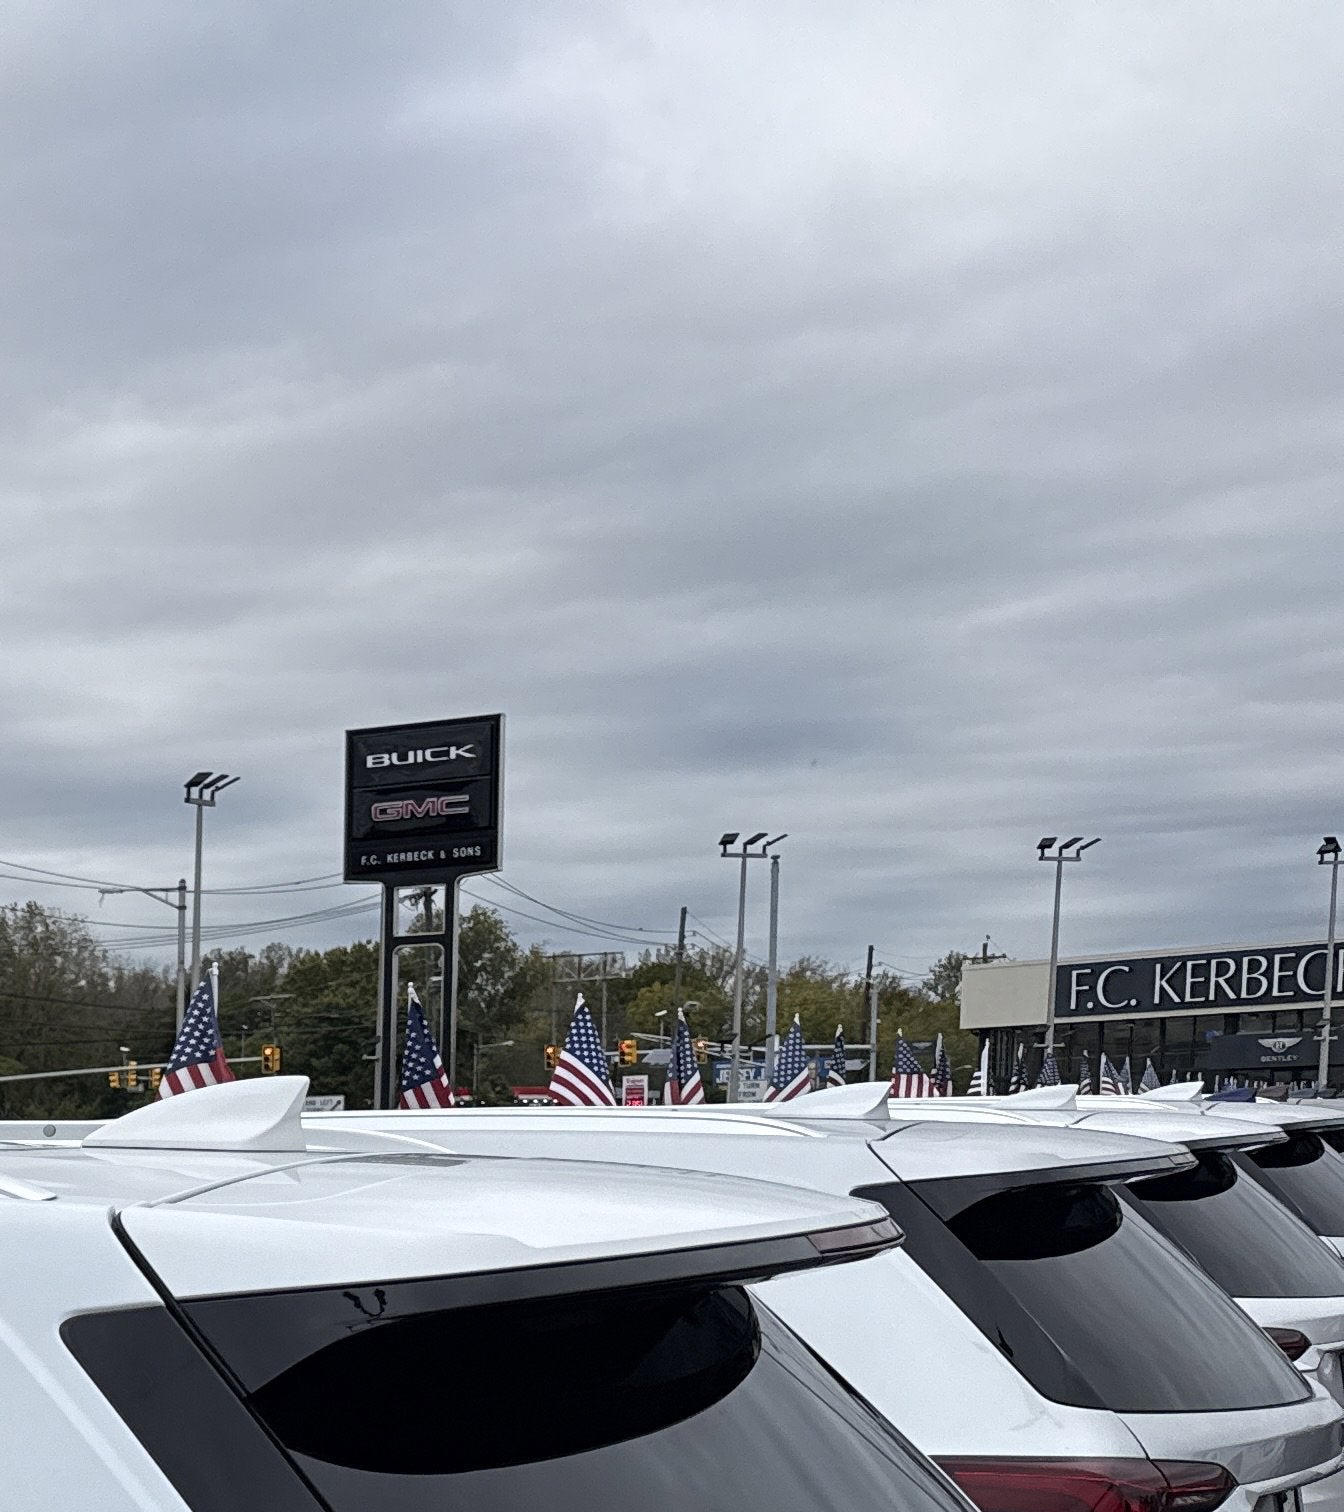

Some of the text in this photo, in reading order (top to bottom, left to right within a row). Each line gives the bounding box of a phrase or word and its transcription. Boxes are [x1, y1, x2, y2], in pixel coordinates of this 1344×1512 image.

[366, 744, 477, 768] BUICK
[371, 795, 470, 821] GMC
[360, 846, 481, 866] F.C. KERBECK & SONS
[1070, 965, 1137, 1010] F.C.
[1260, 1054, 1298, 1062] BENTLEY
[716, 1068, 756, 1084] JESEY
